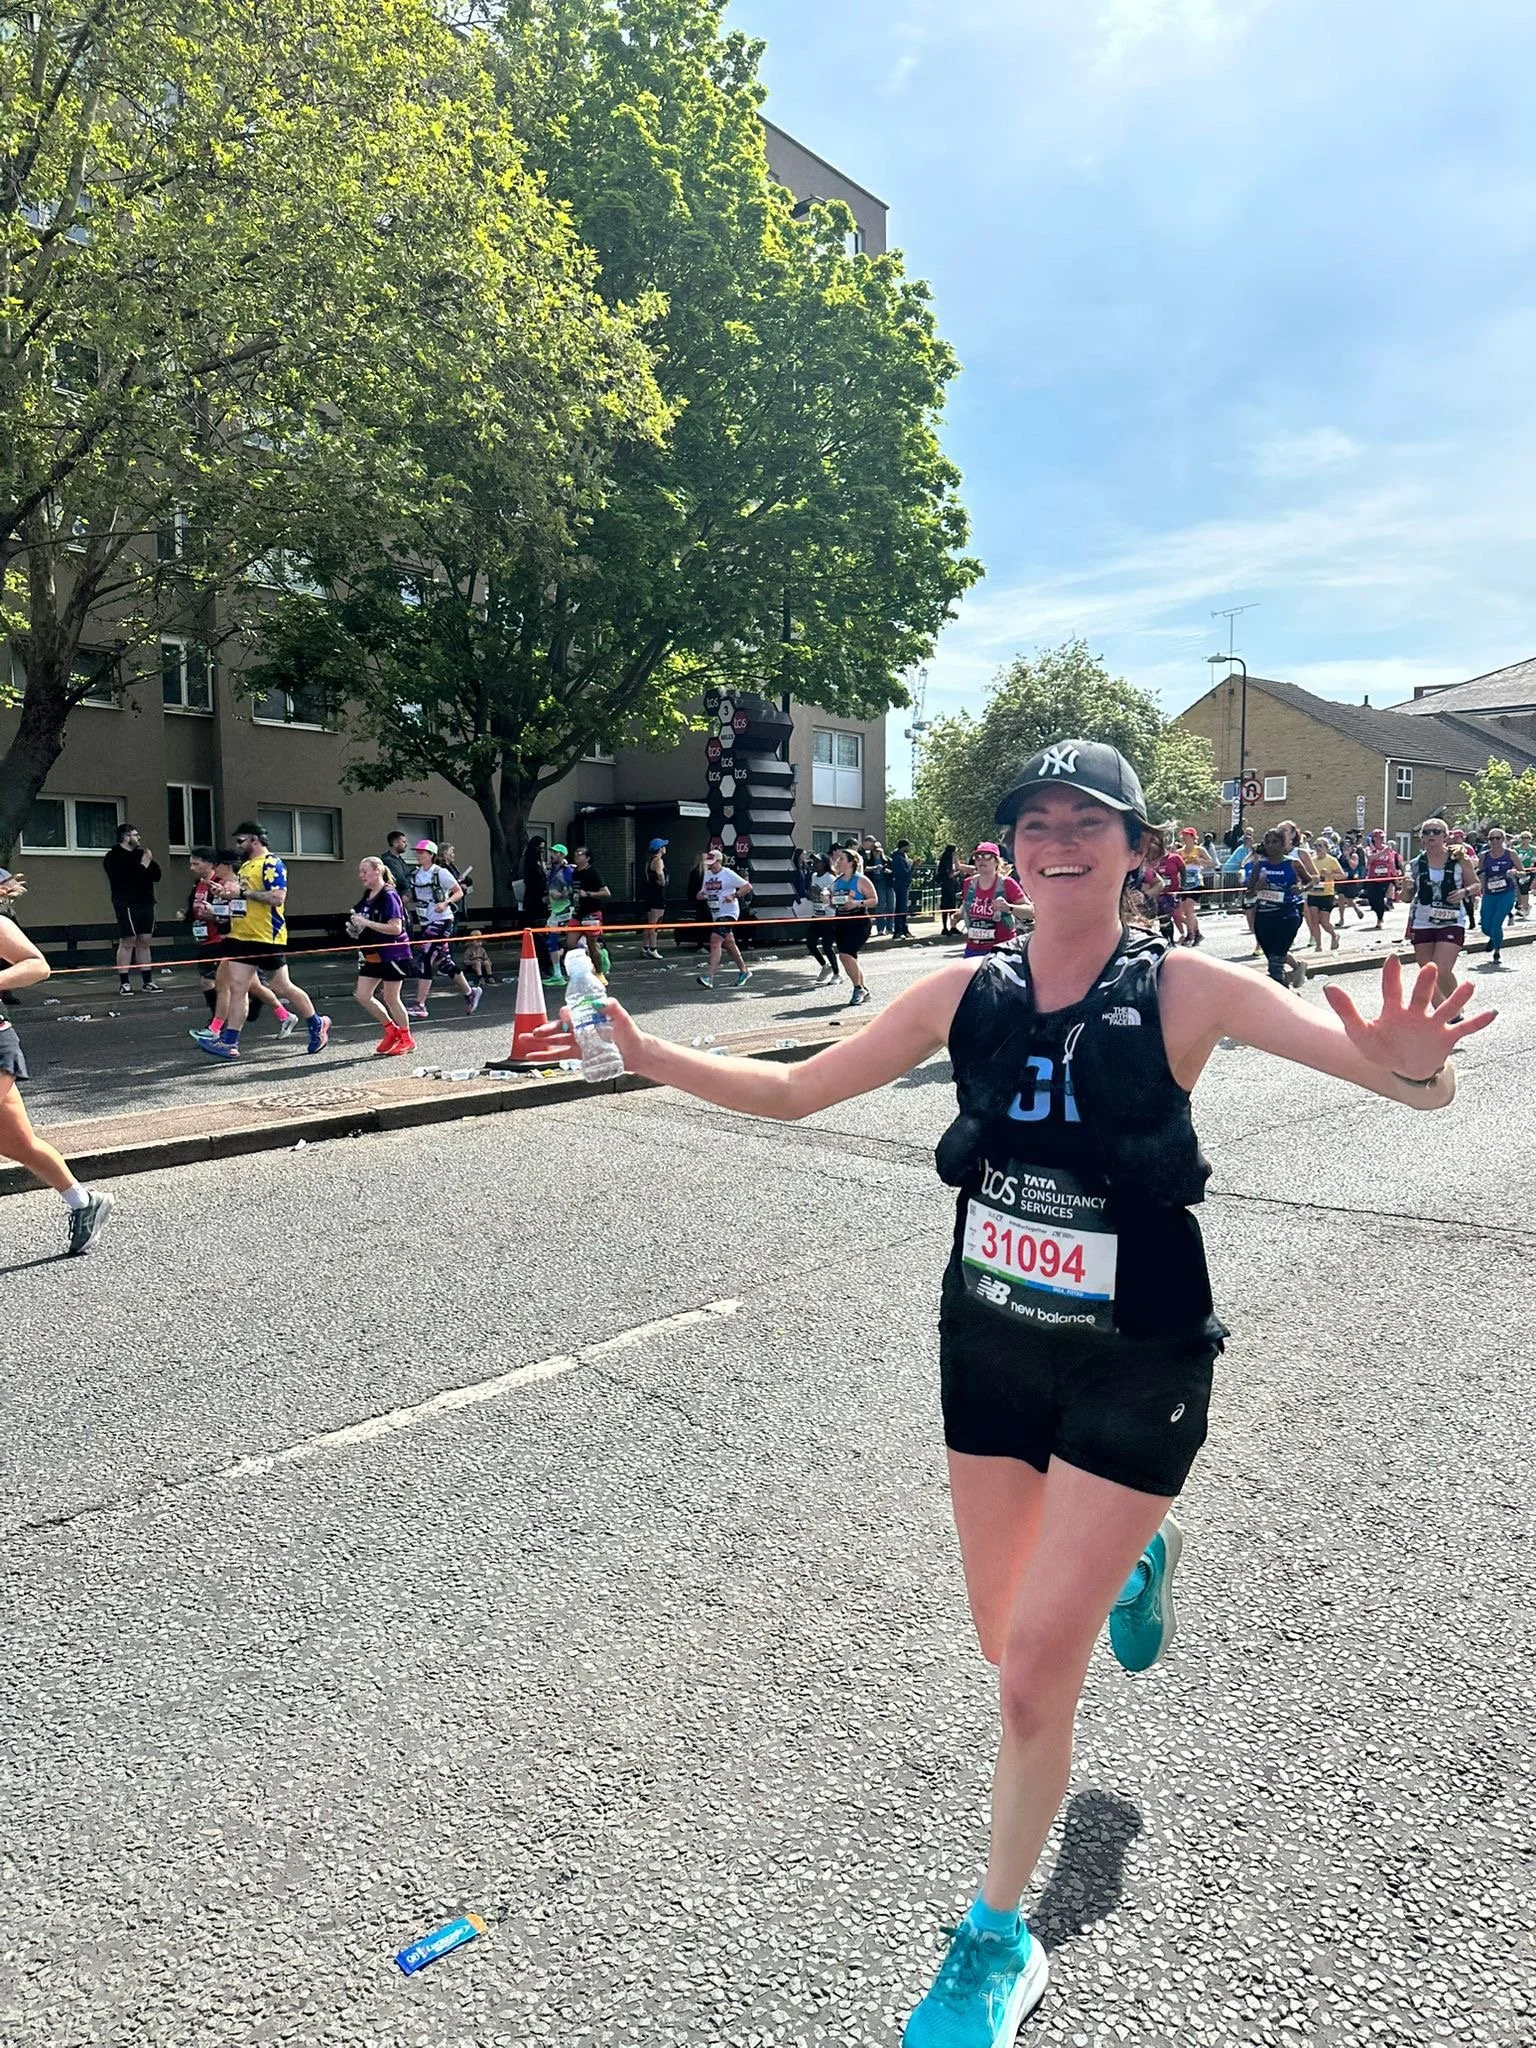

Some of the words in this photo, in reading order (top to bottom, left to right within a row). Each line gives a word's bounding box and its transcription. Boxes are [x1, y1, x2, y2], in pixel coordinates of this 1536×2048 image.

[706, 697, 719, 708] tcs
[723, 705, 729, 716] 3
[733, 717, 747, 729] tcs
[708, 745, 721, 757] tcs
[721, 756, 733, 767] tcs
[1038, 744, 1080, 776] NY
[708, 770, 721, 781] tcs
[734, 768, 747, 779] tcs
[736, 841, 749, 852] tcs
[1102, 1012, 1128, 1020] NORTH
[981, 1158, 1018, 1205] tcs
[1023, 1173, 1057, 1190] TATA
[1021, 1187, 1106, 1209] CONSULTANCY
[1020, 1200, 1074, 1219] SERVICES
[981, 1220, 1086, 1283] 31094
[1011, 1301, 1035, 1317] new
[1037, 1307, 1096, 1324] balance
